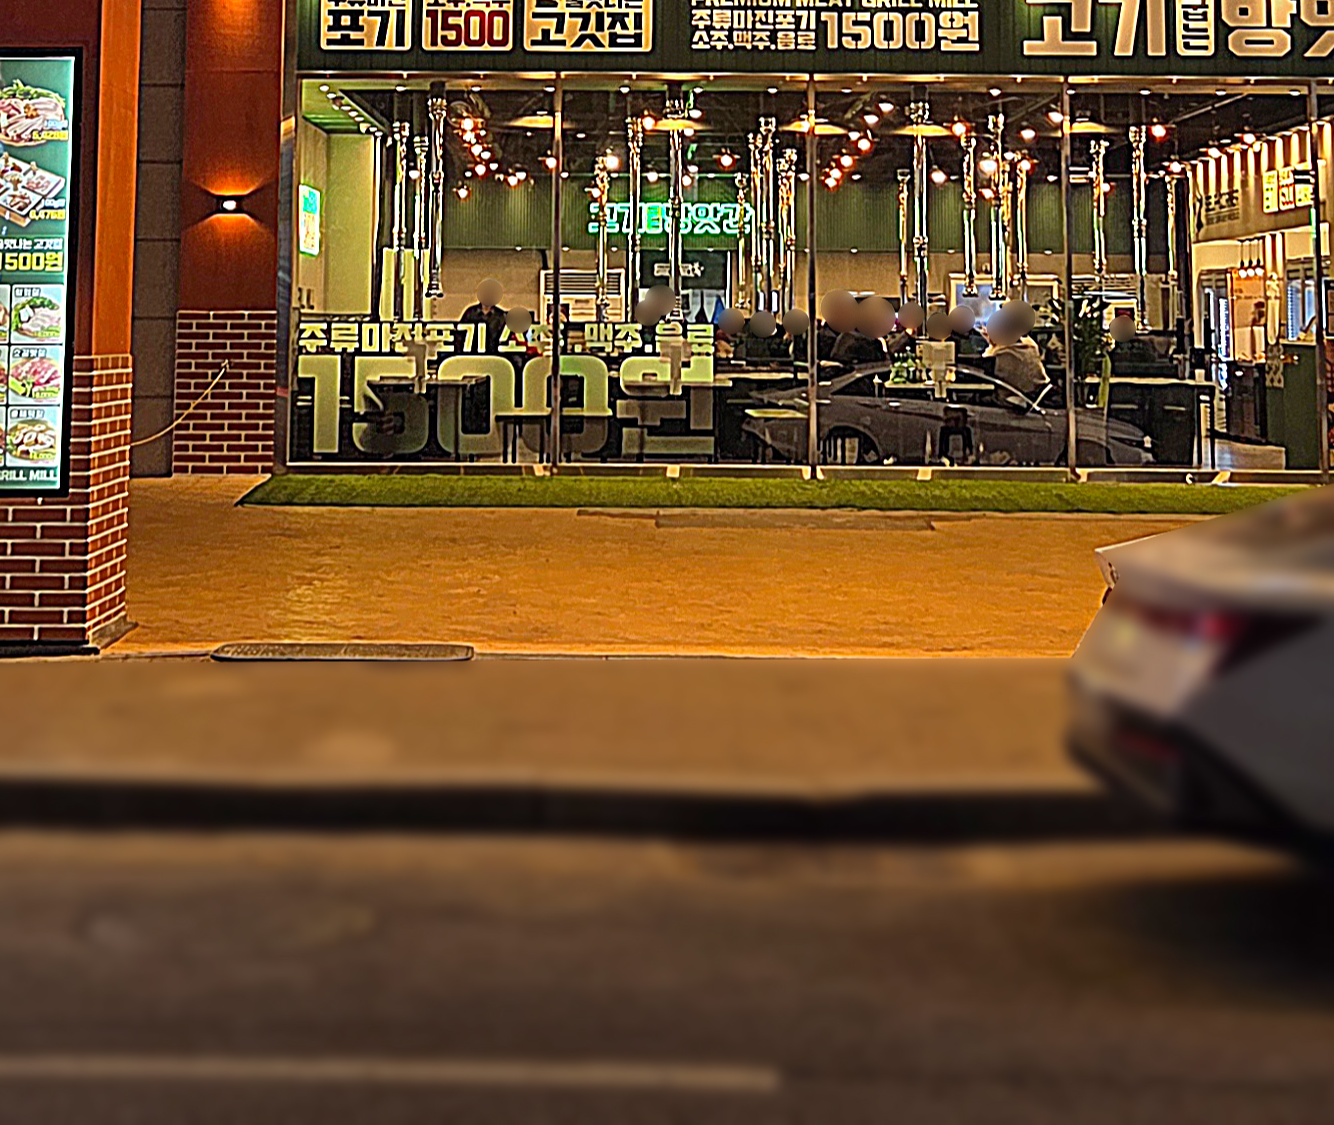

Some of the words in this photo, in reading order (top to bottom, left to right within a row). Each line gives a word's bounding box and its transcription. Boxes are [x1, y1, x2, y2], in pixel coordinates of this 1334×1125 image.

[326, 10, 405, 48] 포기
[425, 10, 511, 48] 1500
[529, 11, 644, 48] 고깃집
[820, 10, 980, 52] 1500원
[28, 469, 58, 482] MILL
